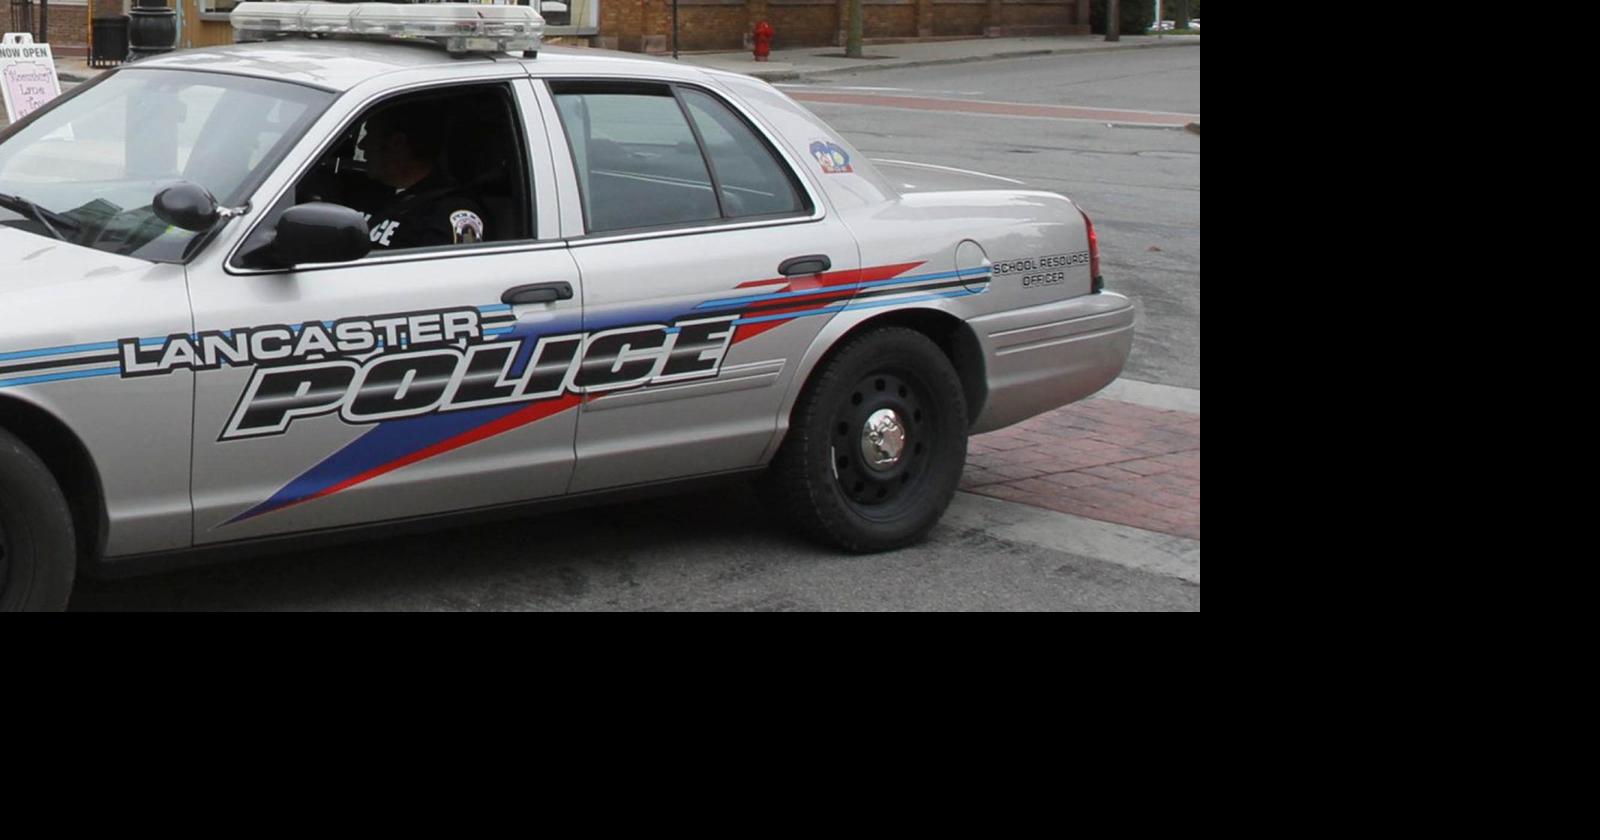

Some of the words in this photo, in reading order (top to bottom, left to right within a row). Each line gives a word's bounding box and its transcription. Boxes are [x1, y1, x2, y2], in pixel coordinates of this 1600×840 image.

[0, 47, 20, 58] NOW
[22, 47, 48, 58] OPEN
[992, 259, 1038, 275] SCHOOL
[1039, 252, 1089, 269] RESOURCE
[1022, 271, 1065, 287] OFFICER
[119, 307, 482, 377] LANCASTER
[219, 313, 740, 440] POLICE
